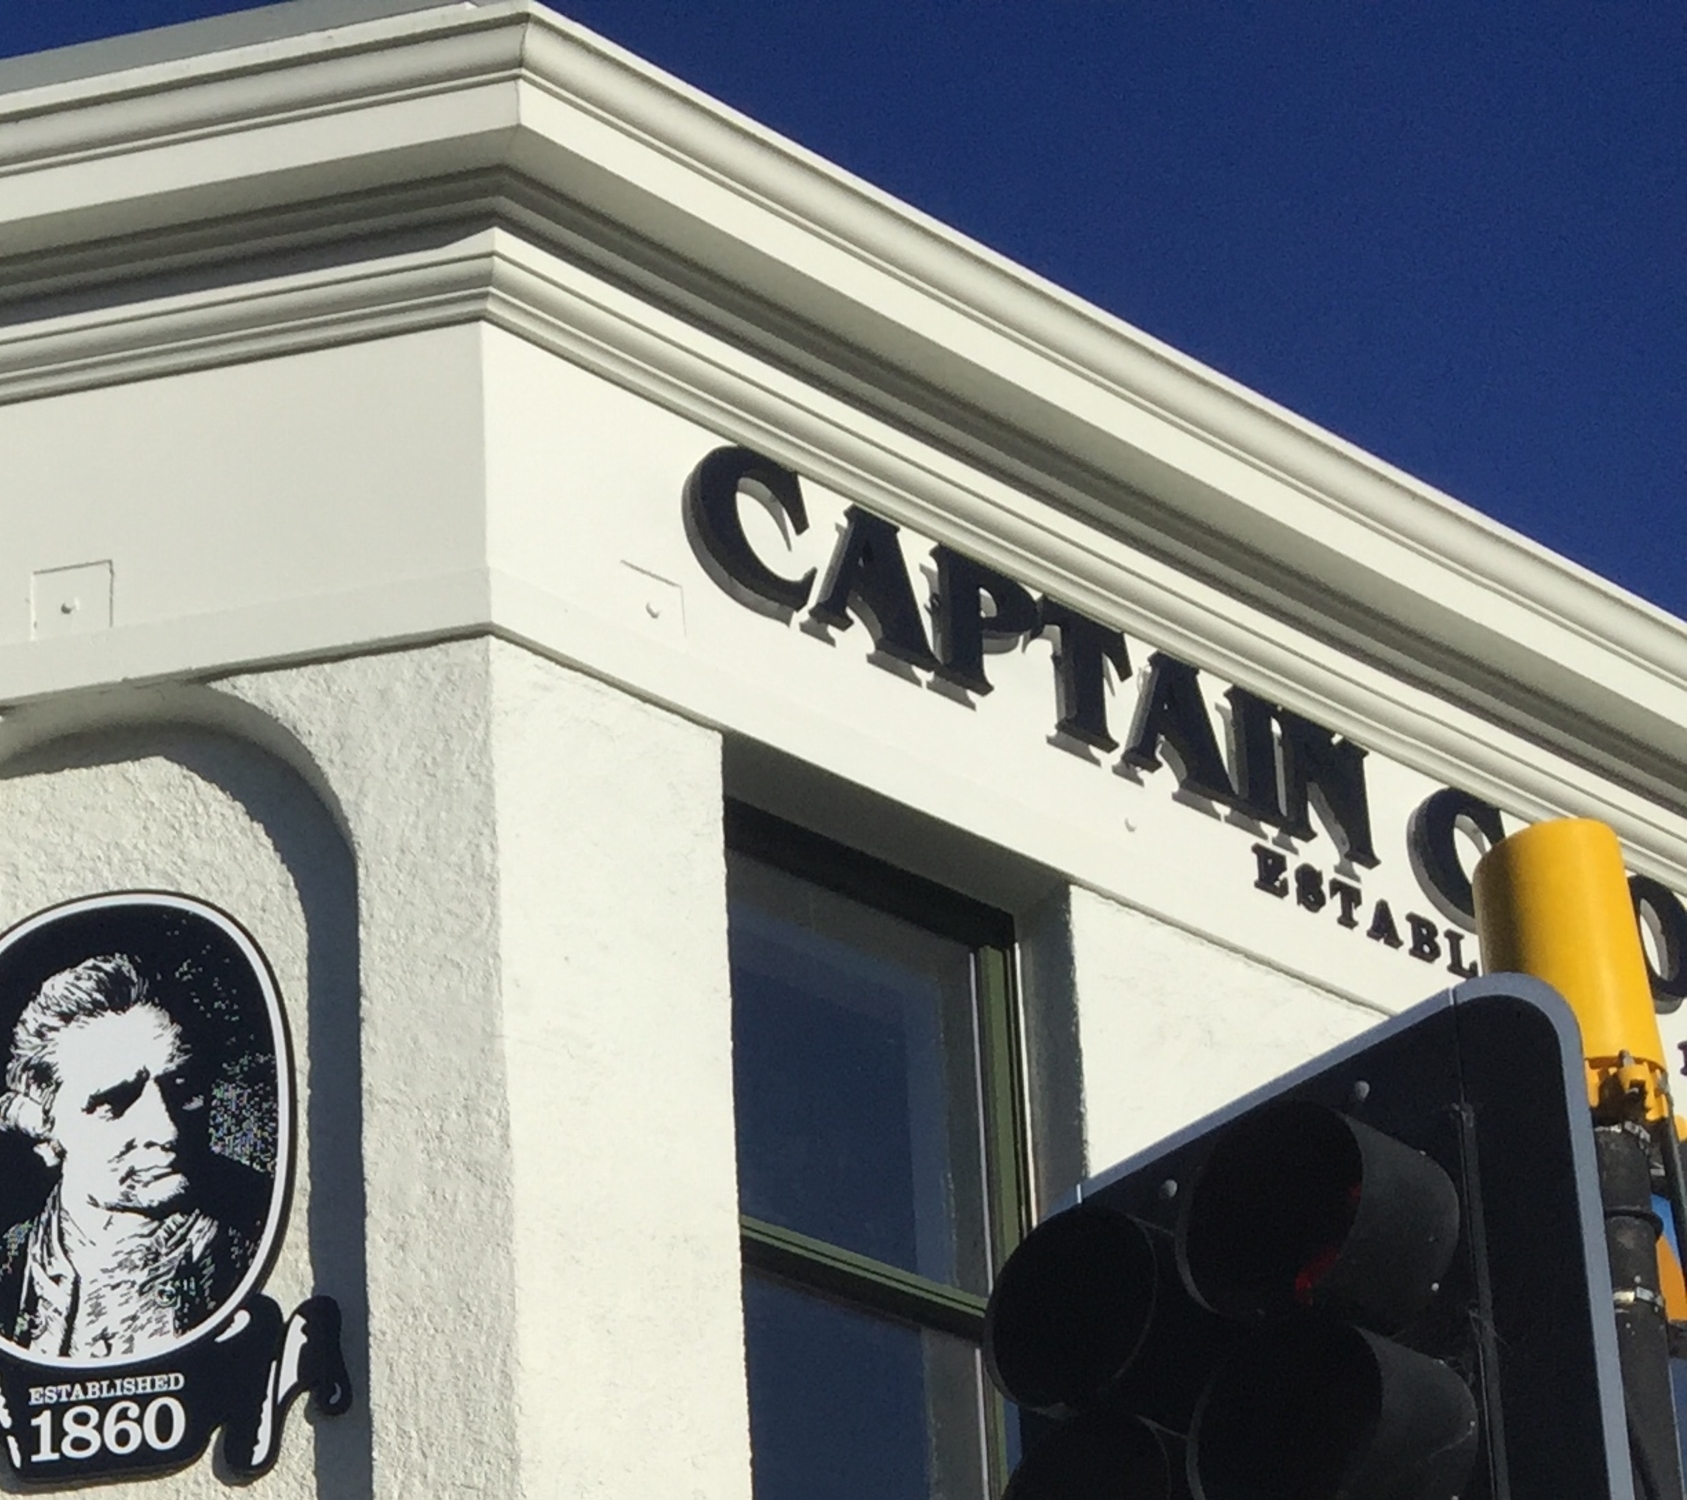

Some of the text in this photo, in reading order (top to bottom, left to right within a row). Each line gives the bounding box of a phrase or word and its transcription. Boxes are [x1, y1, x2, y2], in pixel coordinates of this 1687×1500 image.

[681, 446, 1382, 870] CAPTAIN
[1253, 843, 1479, 980] ESTABL
[28, 1372, 186, 1405] ESTABLISHED
[29, 1397, 187, 1463] 1860
